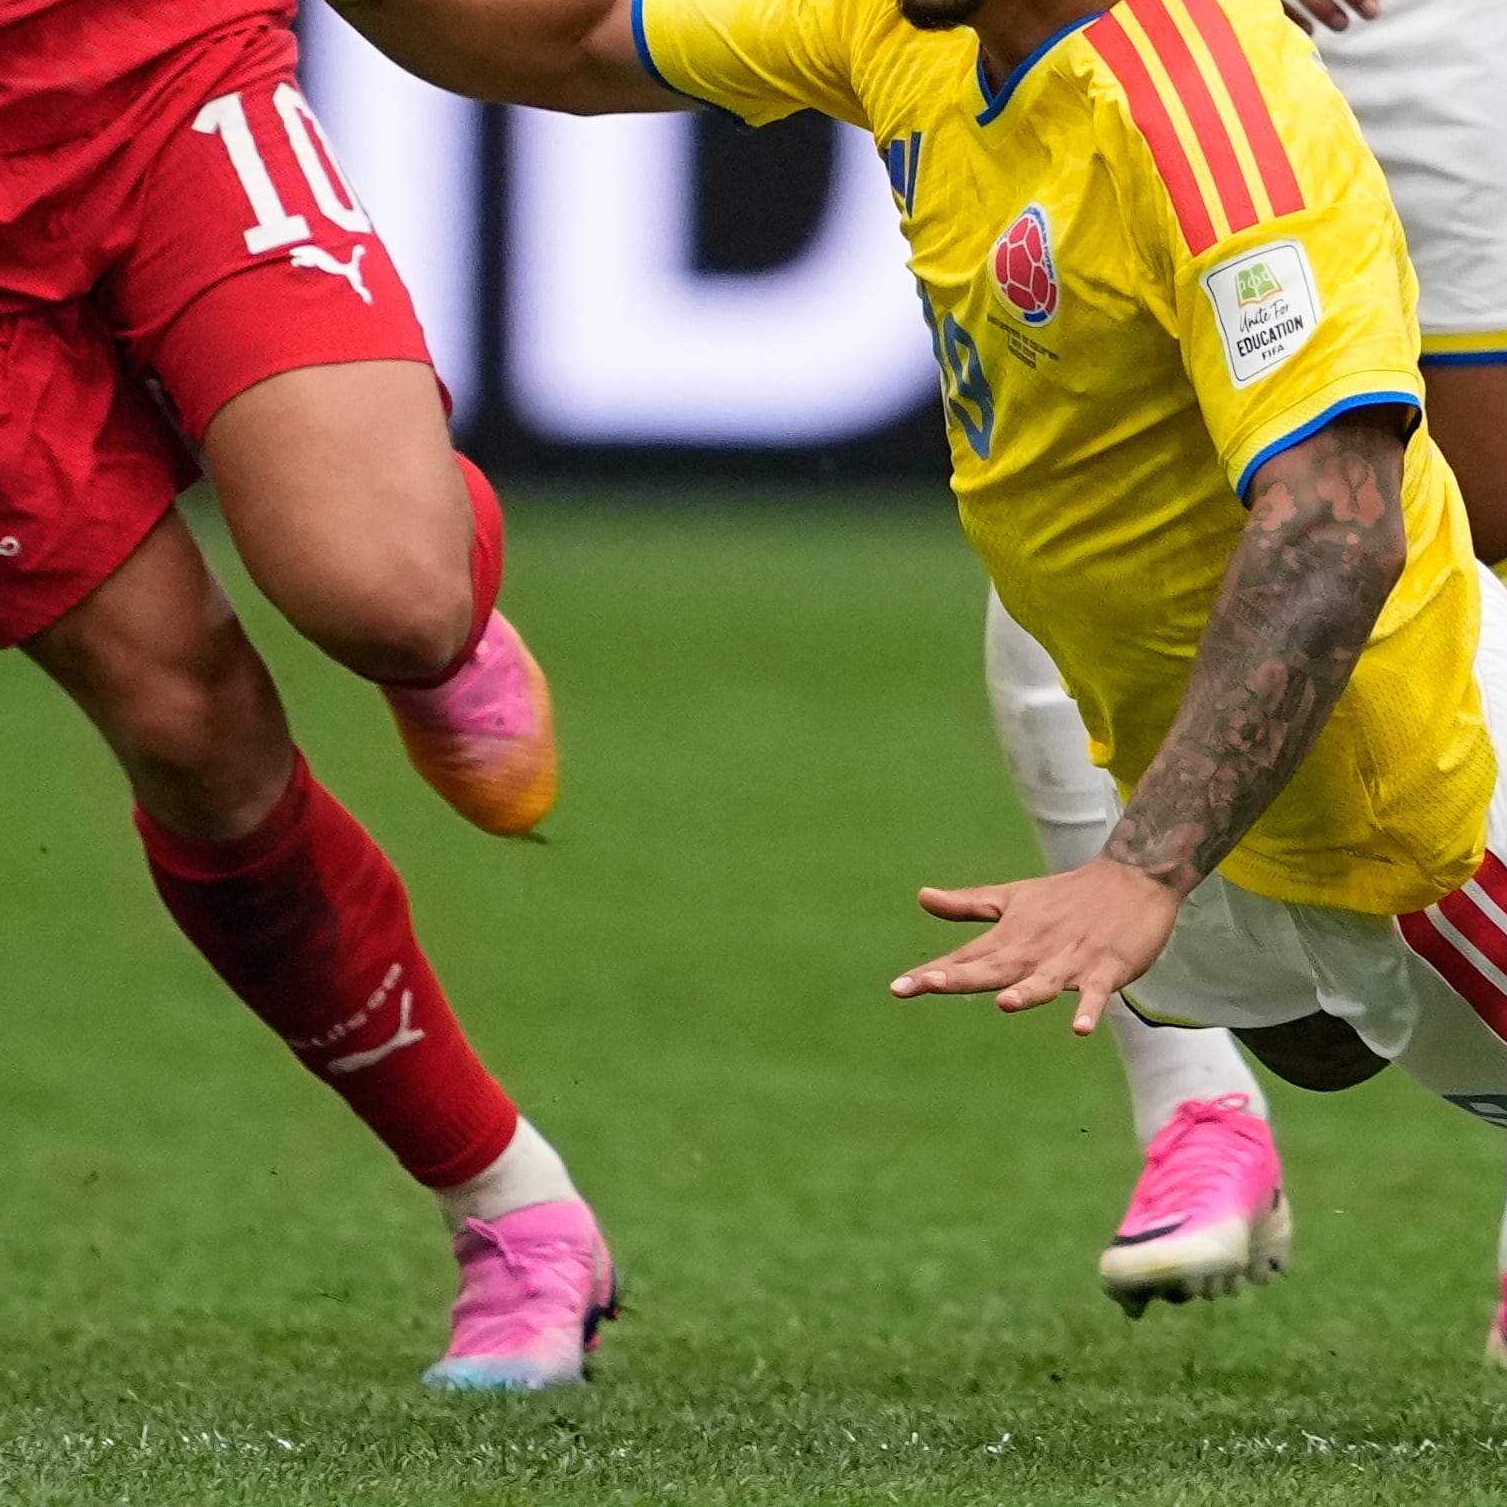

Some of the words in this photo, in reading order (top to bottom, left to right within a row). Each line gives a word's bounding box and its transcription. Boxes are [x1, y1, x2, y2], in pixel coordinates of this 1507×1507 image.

[191, 82, 373, 254] 10
[1240, 305, 1271, 333] Unite
[1270, 298, 1290, 320] For
[1236, 315, 1304, 357] EDUCATION
[1261, 343, 1285, 361] FIFA
